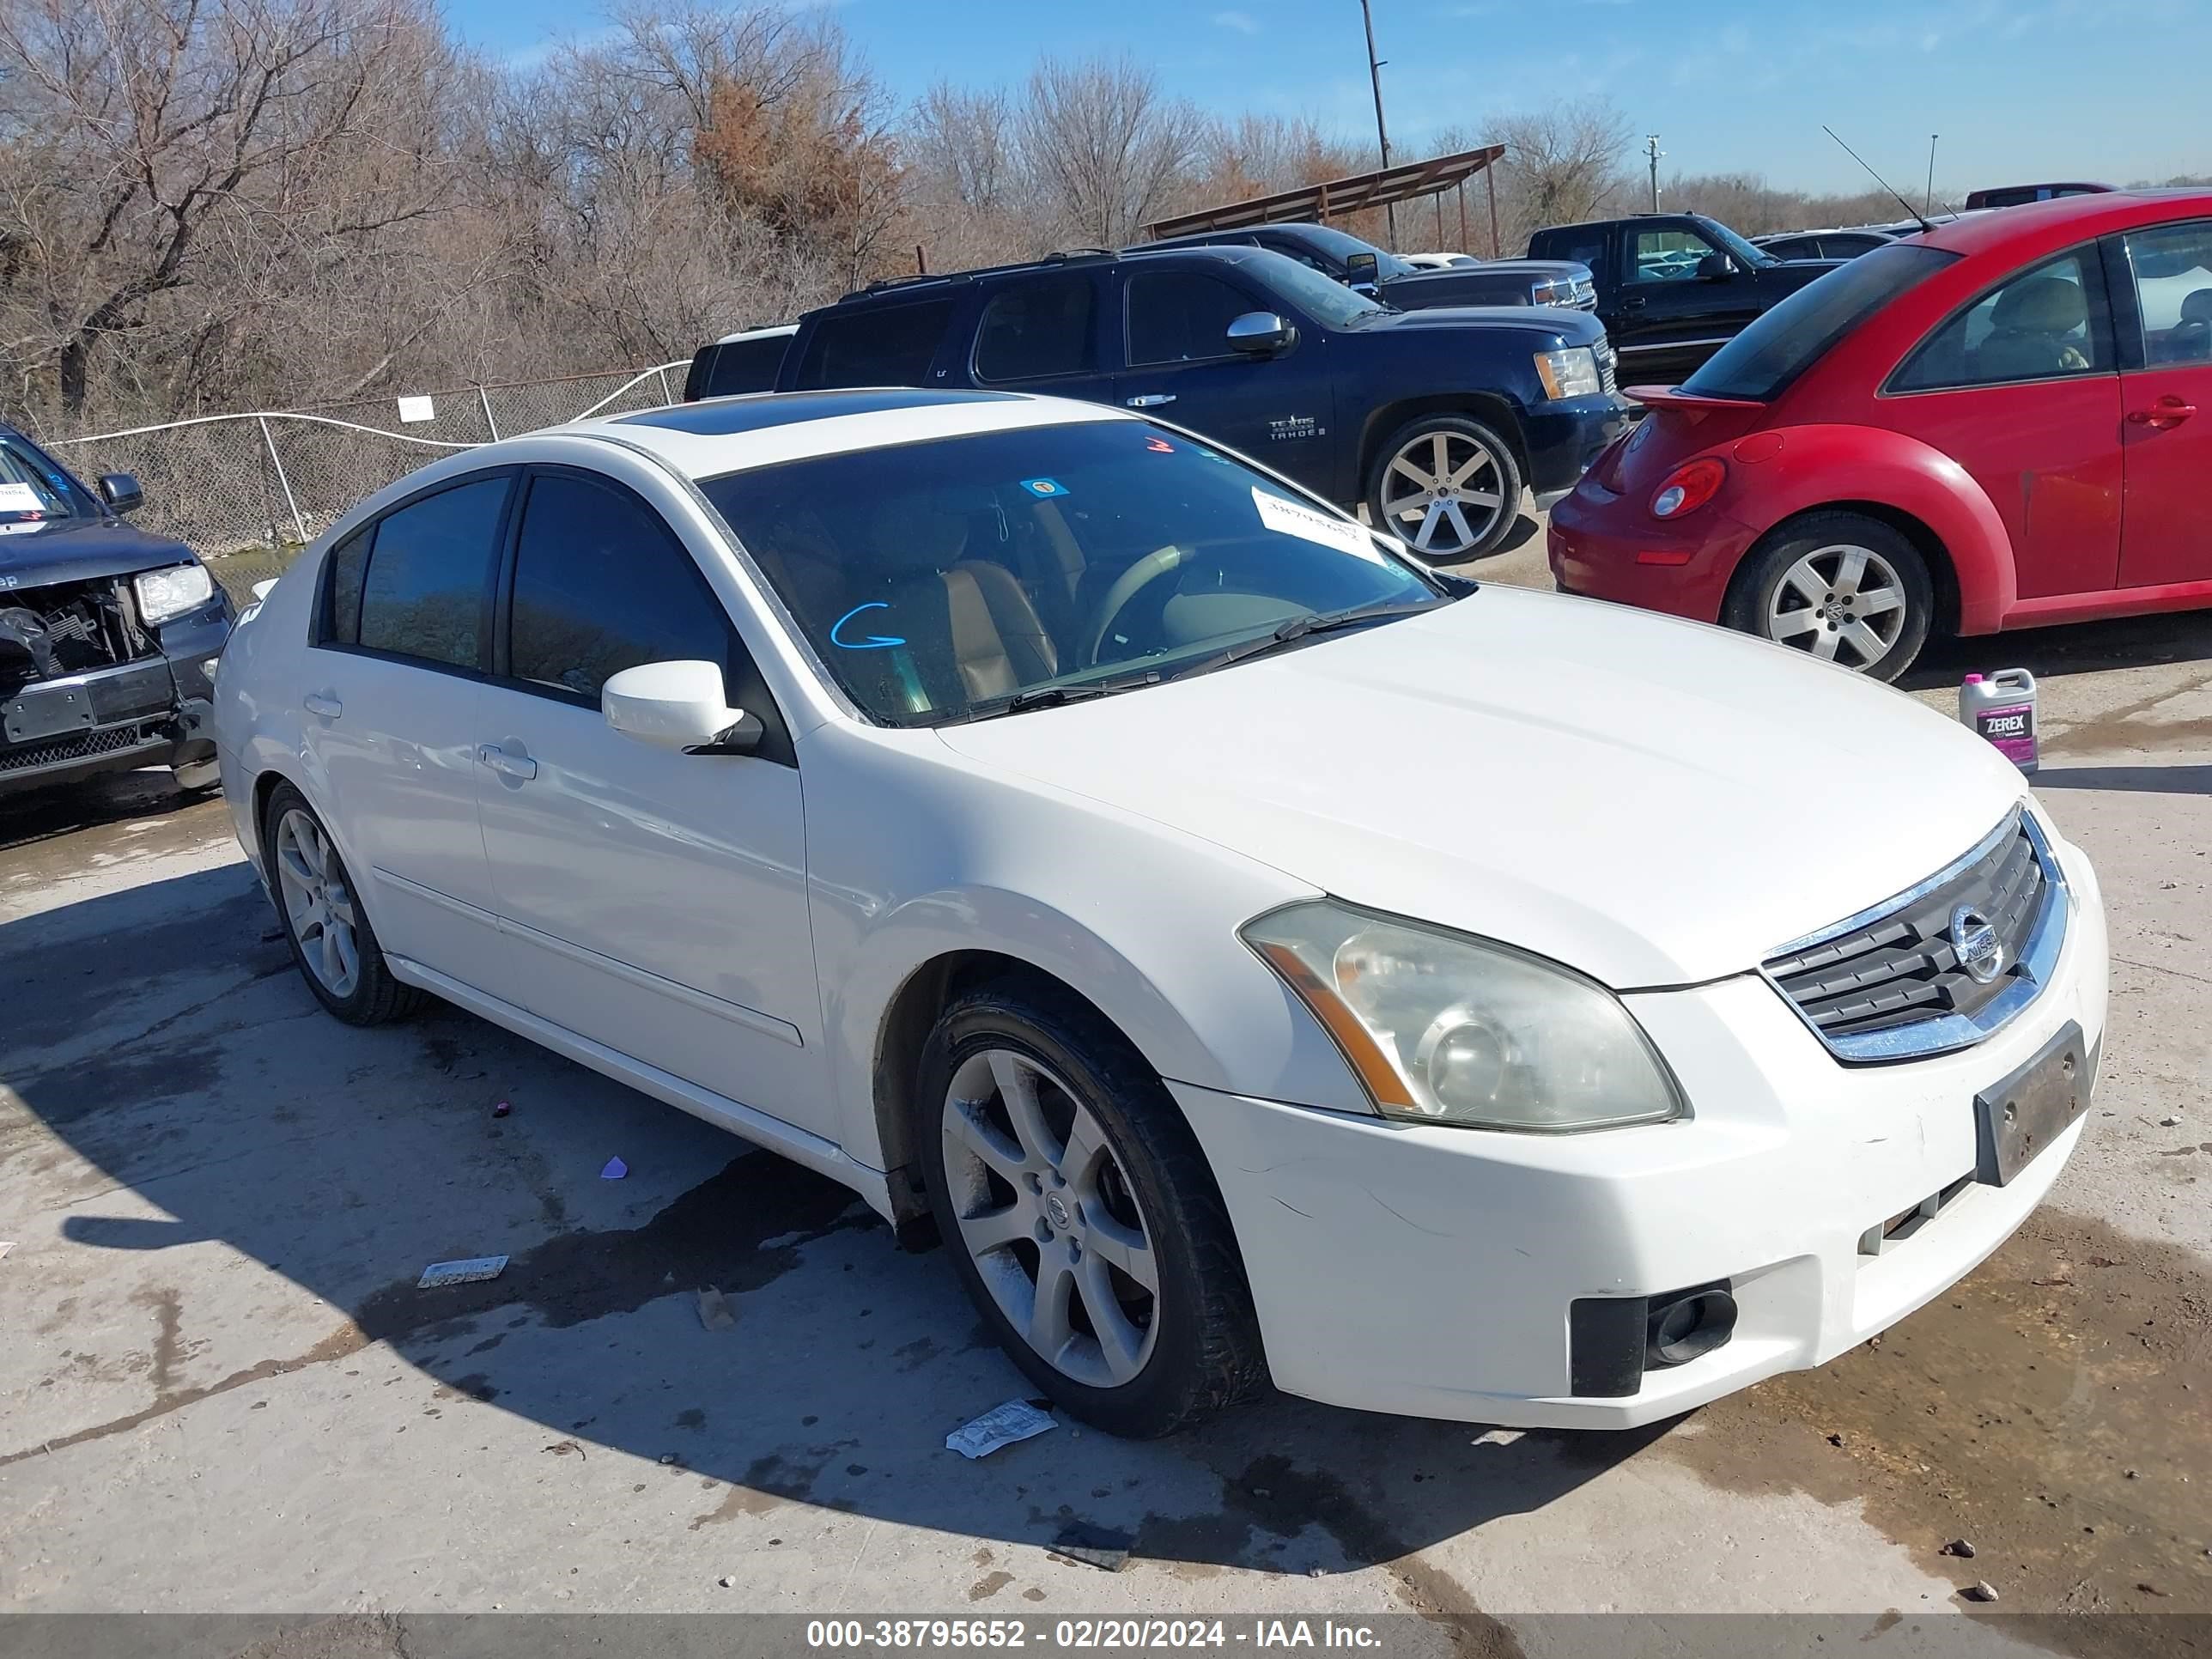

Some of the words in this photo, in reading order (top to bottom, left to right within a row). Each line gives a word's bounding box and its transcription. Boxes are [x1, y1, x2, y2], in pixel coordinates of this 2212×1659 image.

[1269, 416, 1315, 428] TEXAS
[1271, 429, 1315, 440] TAHOE
[830, 603, 907, 648] G
[1986, 714, 2024, 733] ZEREX
